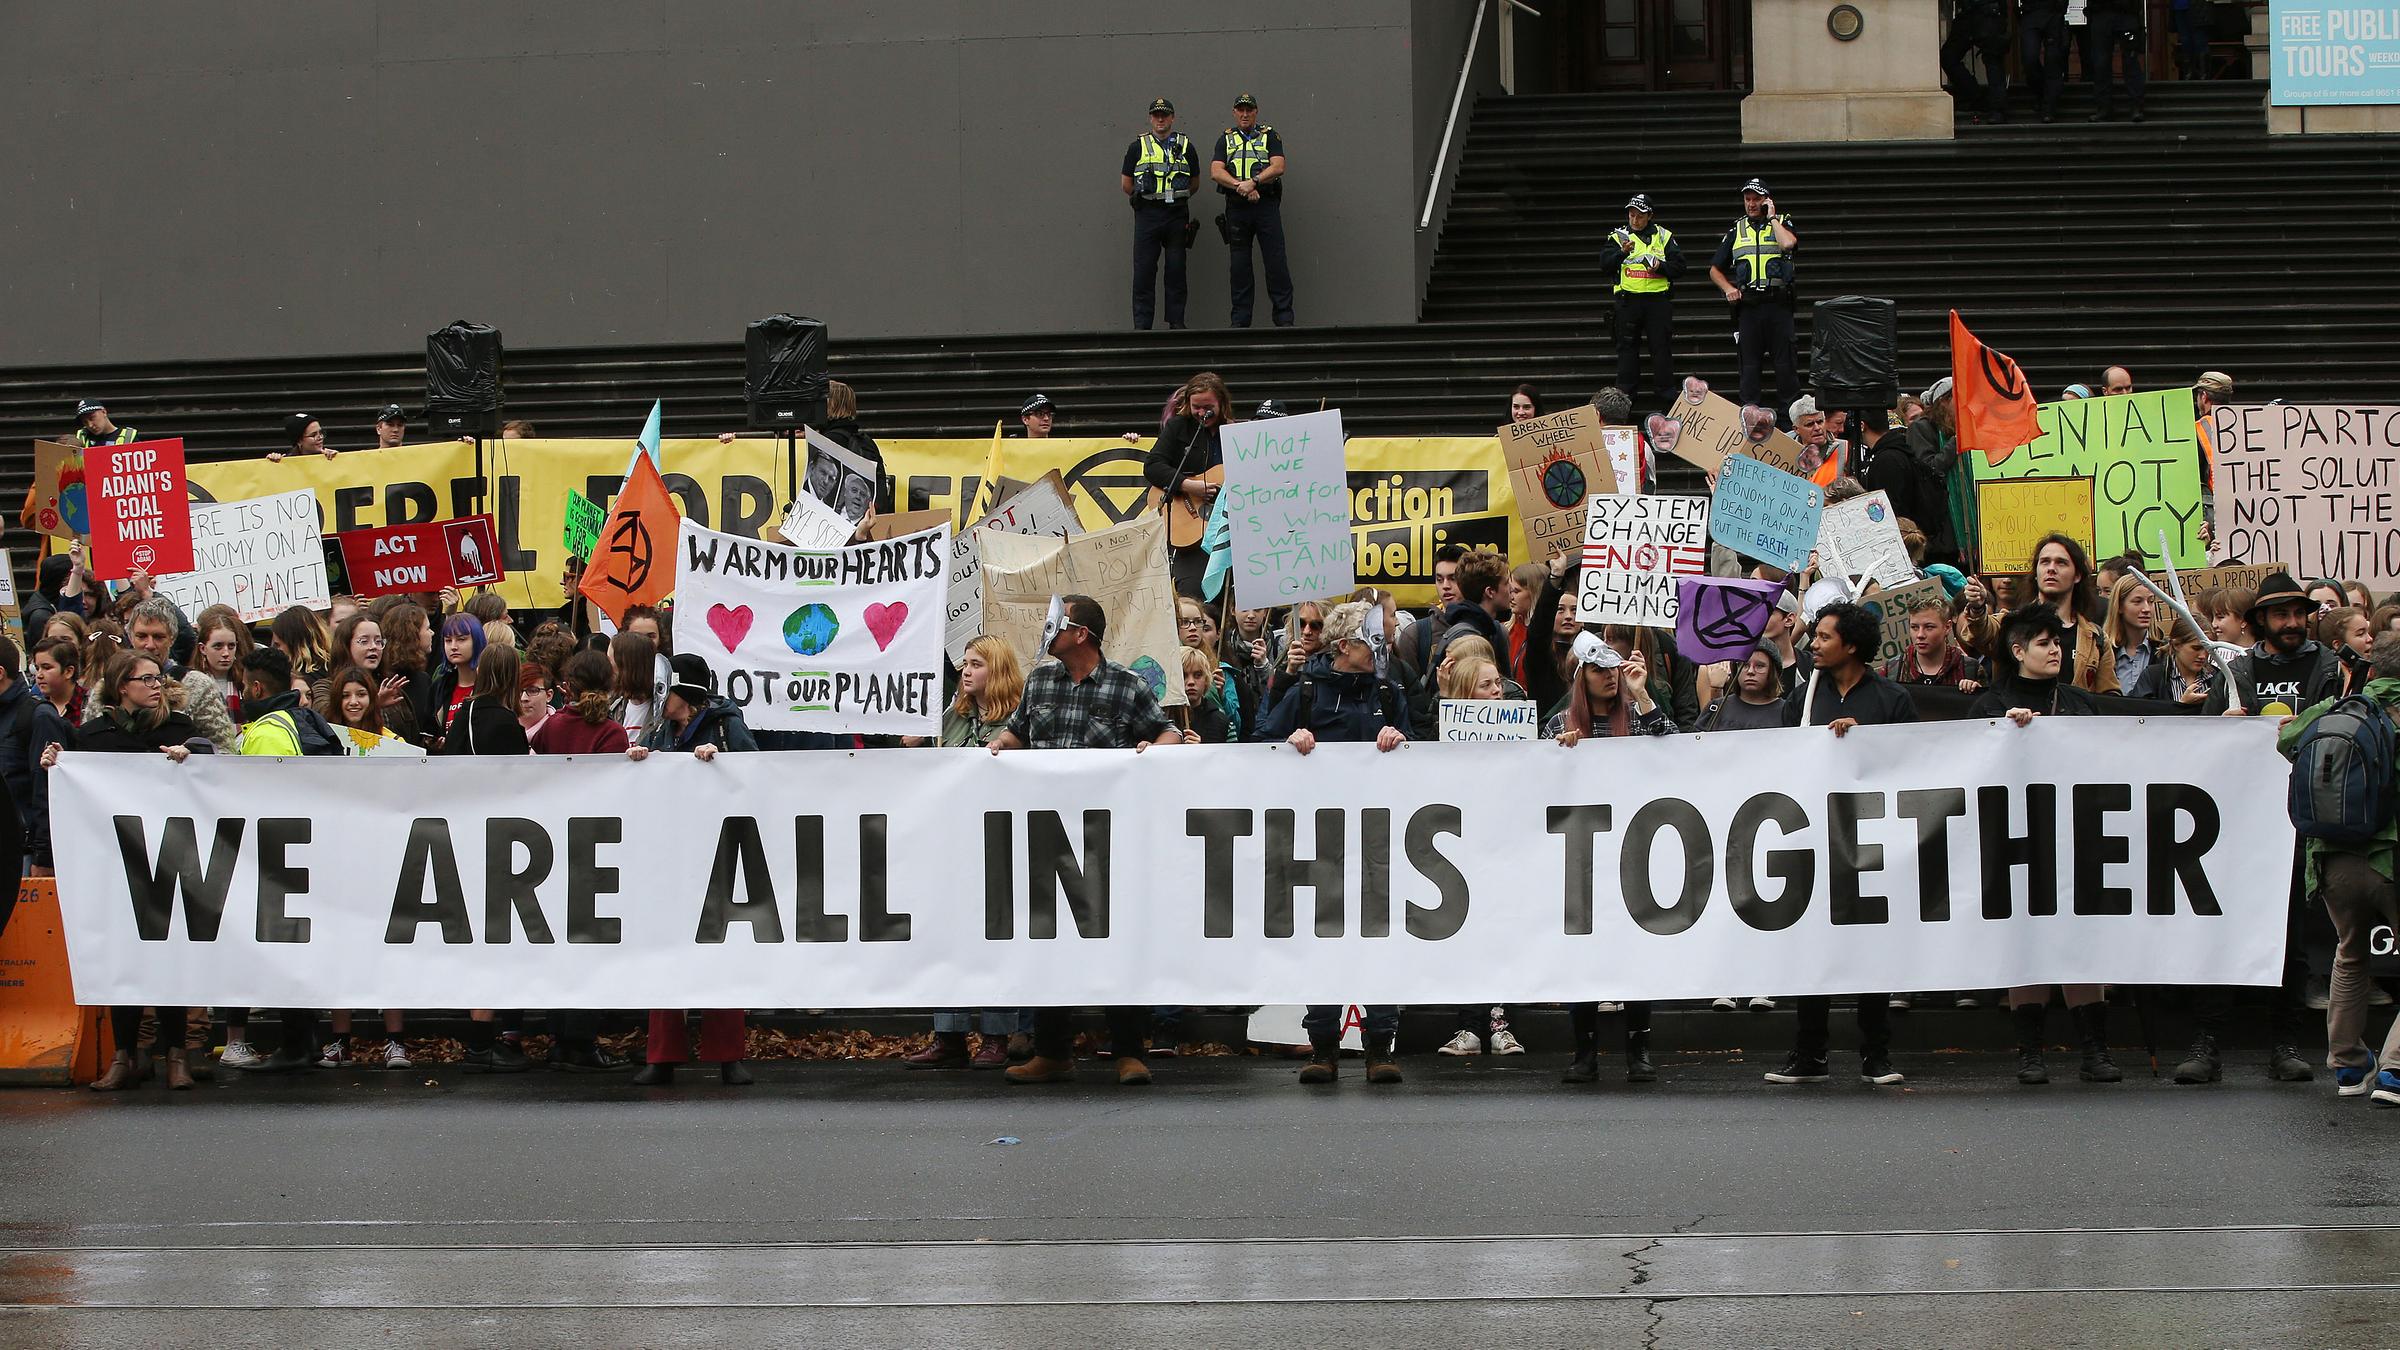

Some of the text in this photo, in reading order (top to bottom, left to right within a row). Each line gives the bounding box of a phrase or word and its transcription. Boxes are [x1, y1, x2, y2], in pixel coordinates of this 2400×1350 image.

[2281, 9, 2400, 41] FREE PUBLI
[2282, 45, 2400, 77] TOURS WEEKD
[2283, 89, 2312, 98] Groups
[2360, 88, 2375, 96] call
[1511, 412, 1579, 437] BREAK THE
[2215, 406, 2266, 453] BE
[1232, 431, 1311, 461] What
[1531, 429, 1576, 446] WHEEL
[1715, 426, 1744, 455] UP
[111, 449, 157, 474] STOP
[1271, 458, 1304, 472] WE
[101, 470, 173, 498] ADANI'S
[1782, 480, 1799, 494] NO
[2221, 456, 2397, 494] THE SOLUT
[116, 495, 163, 519] COAL
[1230, 481, 1342, 511] Stand for
[1720, 478, 1810, 525] ECONOMY ON A
[1983, 482, 2069, 512] RESPECT
[234, 503, 264, 533] IS
[276, 493, 311, 525] NO
[783, 499, 816, 540] BYE
[1592, 498, 1706, 521] SYSTEM
[1720, 498, 1752, 520] DEAD
[2234, 493, 2392, 526] NOT THE
[117, 517, 165, 542] MINE
[1534, 516, 1556, 537] OF
[1589, 519, 1701, 544] CHANGE
[1994, 513, 2040, 535] YOUR
[265, 530, 296, 560] ON
[304, 524, 323, 553] A
[374, 535, 417, 557] ACT
[953, 541, 969, 559] it's
[1109, 533, 1129, 547] NOT
[1267, 531, 1311, 549] WE
[1548, 537, 1571, 552] AND
[1714, 519, 1732, 535] PUT
[1736, 527, 1754, 543] THE
[1756, 534, 1789, 558] EARTH
[1985, 539, 2035, 559] MOTHE
[688, 534, 787, 581] WARM
[793, 553, 839, 580] OUR
[841, 531, 942, 585] HEARTS
[953, 555, 980, 583] out
[1248, 539, 1353, 576] STAND
[1606, 543, 1680, 574] NOT
[1984, 564, 2000, 572] ALL
[373, 565, 427, 588] NOW
[990, 550, 1089, 594] DENIAL
[2212, 574, 2219, 588] A
[233, 561, 323, 614] PLANET
[1278, 574, 1329, 596] ON!
[1581, 591, 1679, 618] CHANG
[710, 668, 936, 717] OT OUR PLANET
[2256, 681, 2300, 695] LACK
[1441, 704, 1536, 725] THE CLIMATE
[112, 783, 2223, 944] WE ARE ALL IN THIS TOGETHER
